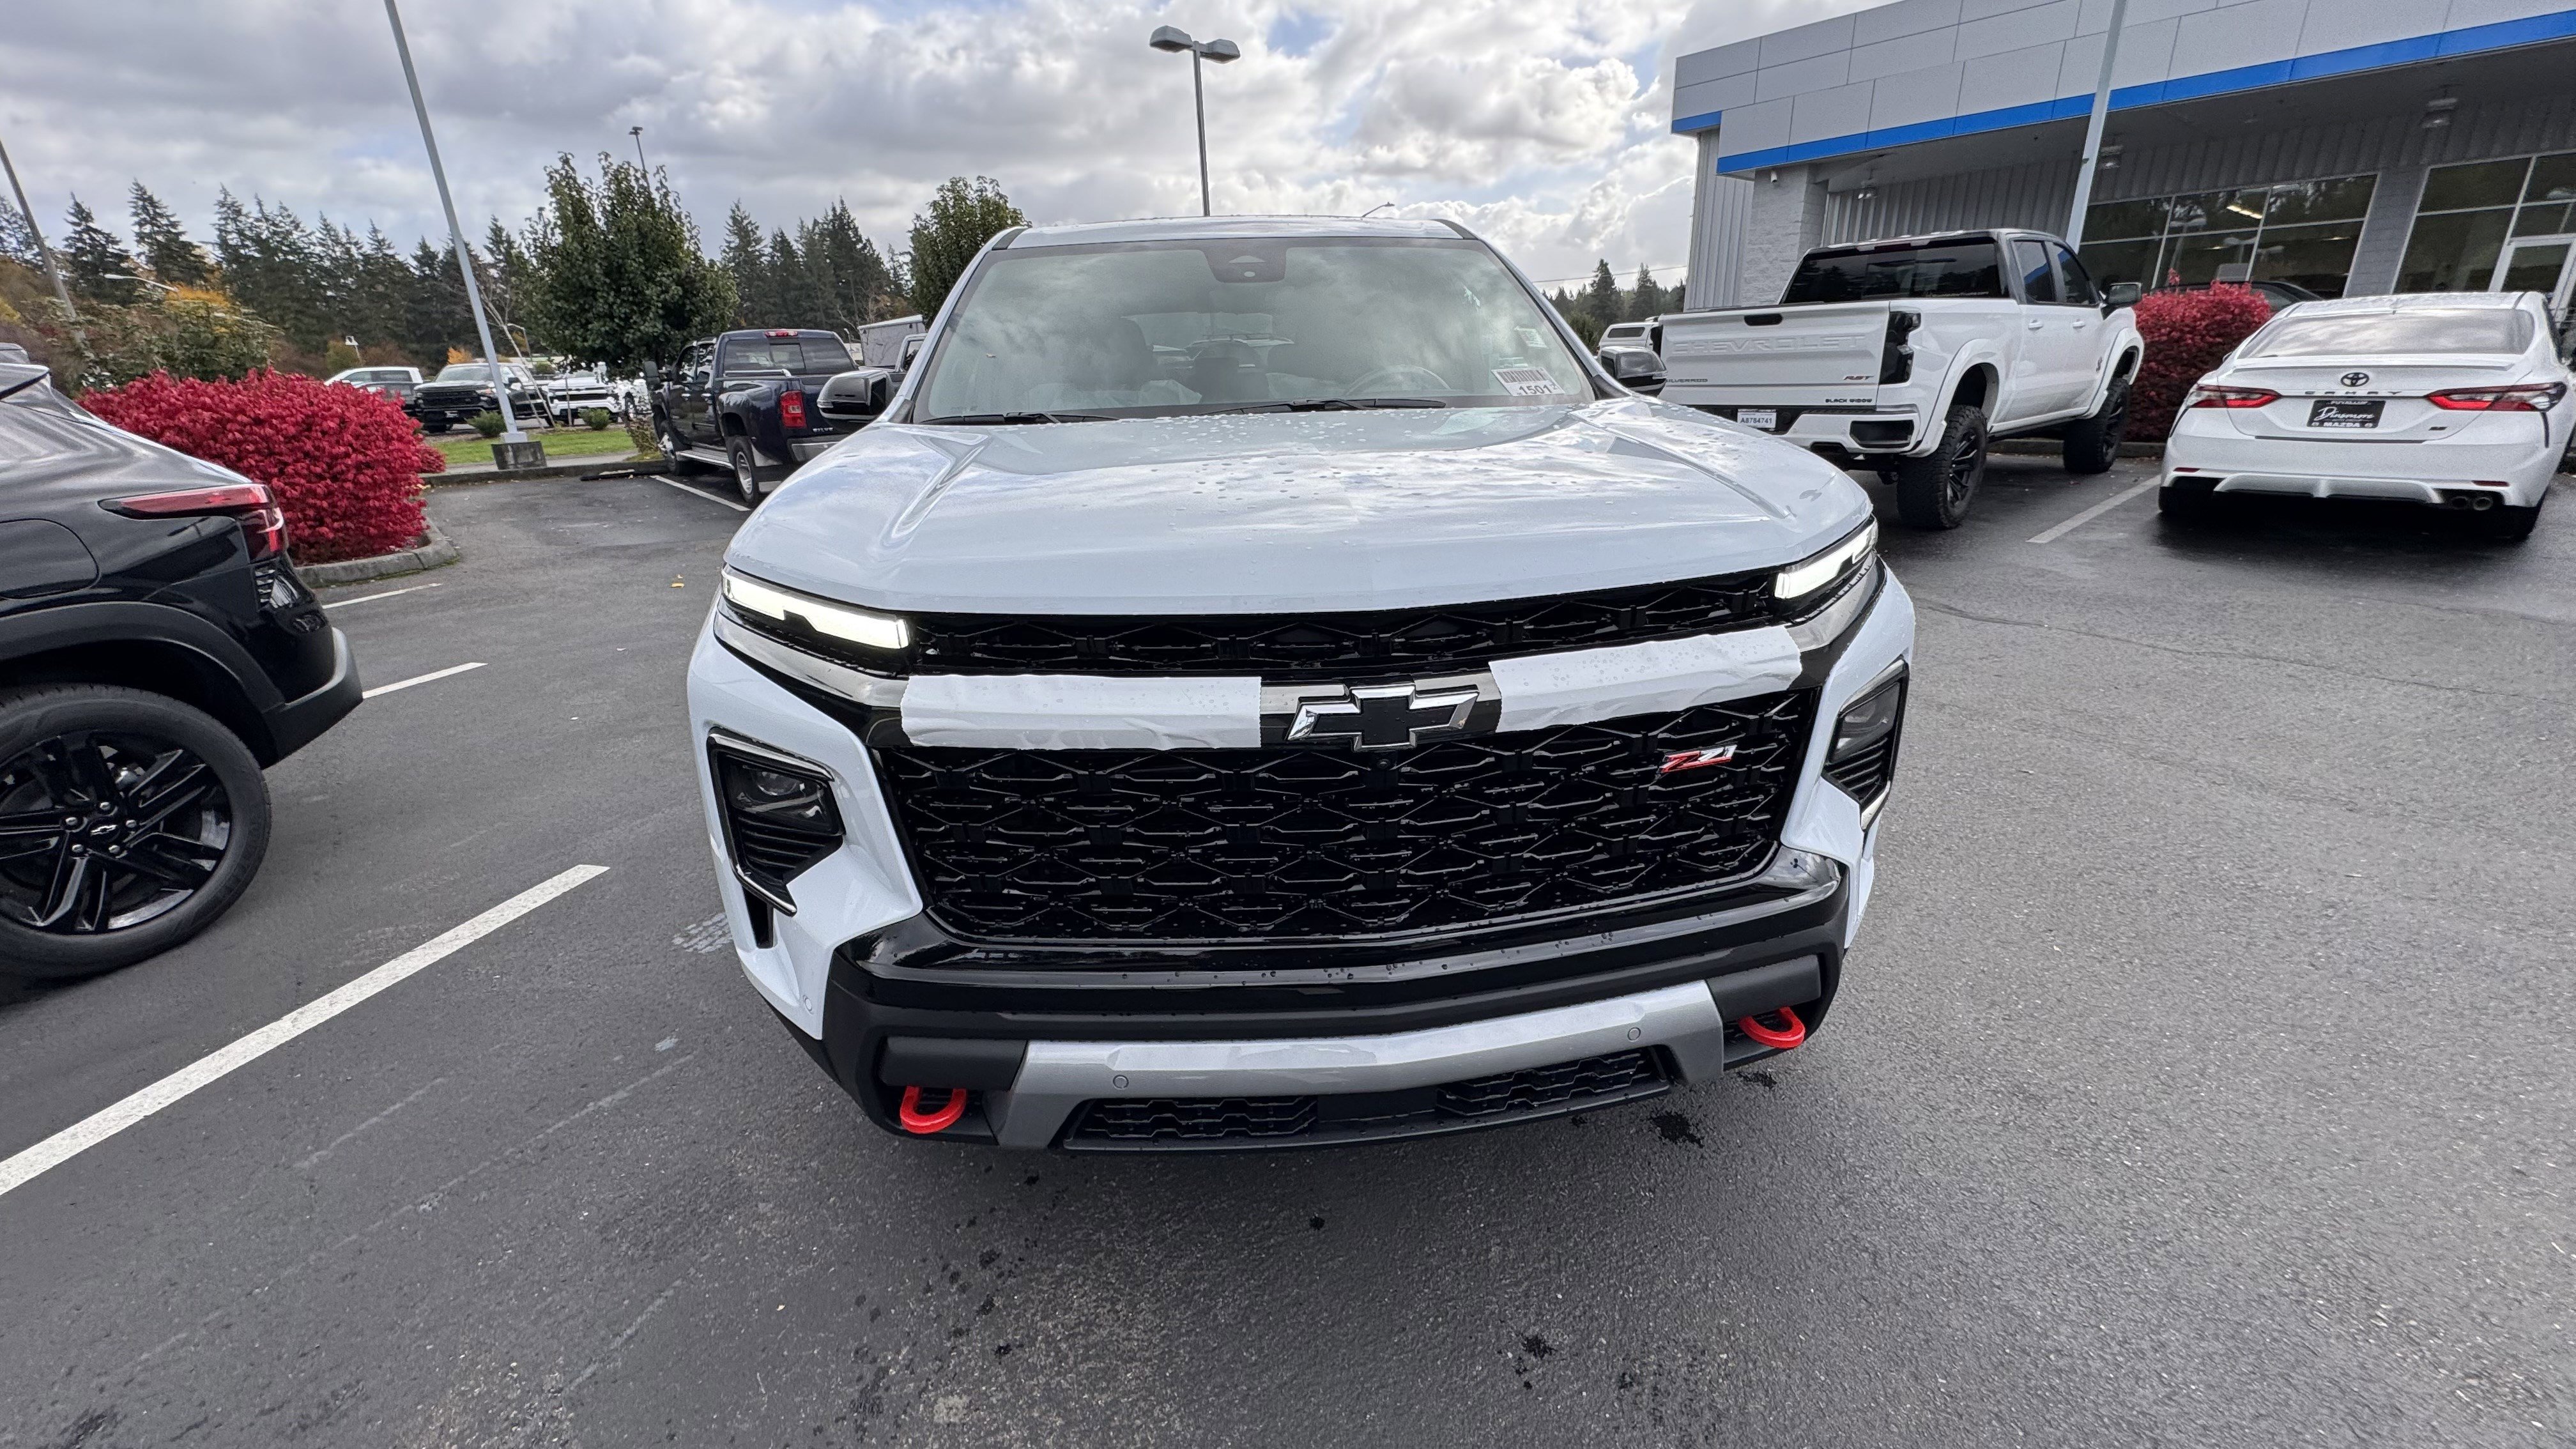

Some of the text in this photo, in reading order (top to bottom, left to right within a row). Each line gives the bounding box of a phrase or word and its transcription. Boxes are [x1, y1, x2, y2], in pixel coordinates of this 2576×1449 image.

[1672, 335, 1866, 354] CHEVROLET
[1519, 385, 1553, 395] 1501
[1660, 744, 1738, 773] Z71
